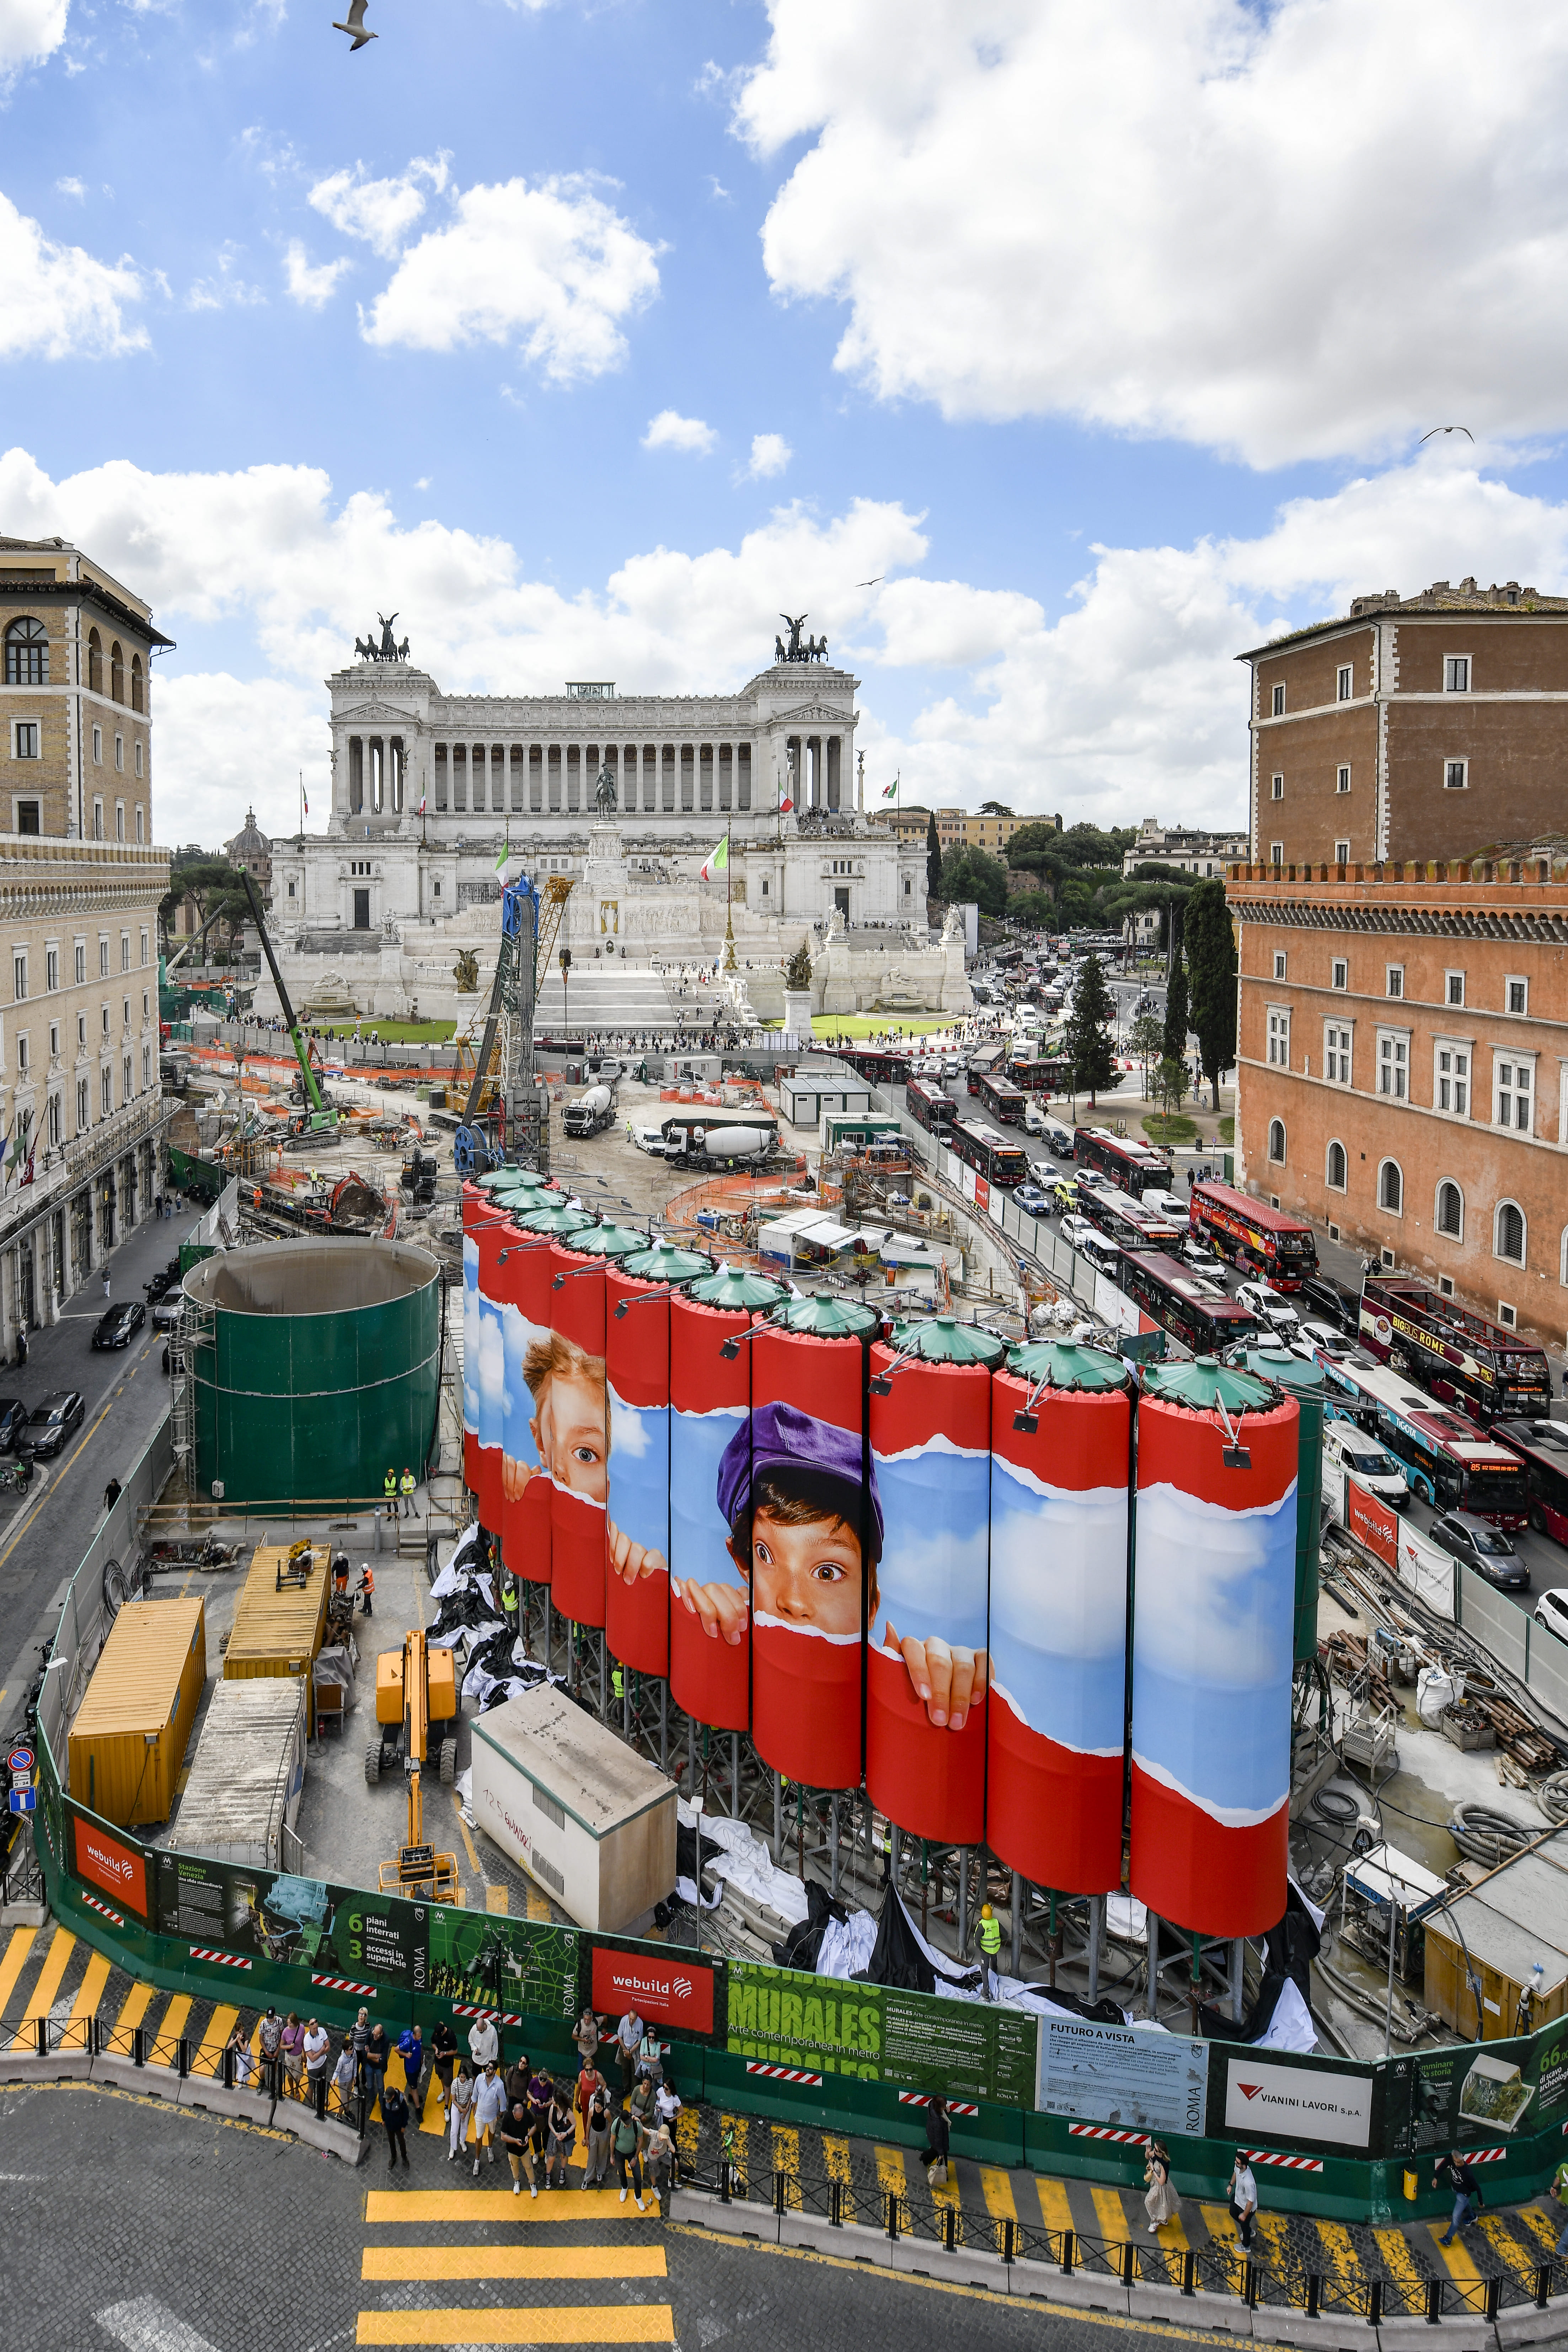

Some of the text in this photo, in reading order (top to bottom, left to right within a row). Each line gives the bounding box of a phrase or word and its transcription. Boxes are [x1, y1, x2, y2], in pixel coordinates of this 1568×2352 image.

[1419, 1332, 1445, 1355] ROME
[87, 1844, 120, 1872] webuild
[178, 1863, 206, 1874] Stazione
[178, 1869, 204, 1880] Venezia
[197, 1879, 223, 1889] straordinaria
[349, 1914, 363, 1932] 6
[366, 1916, 387, 1927] piani
[366, 1925, 399, 1939] interrati
[349, 1939, 362, 1959] 3
[366, 1945, 403, 1959] accessi in
[366, 1953, 406, 1968] superficie
[414, 1947, 425, 1988] ROMA
[613, 1976, 669, 1994] webuild
[563, 1973, 574, 2016] ROMA
[632, 1997, 658, 2005] Partecipazioni
[728, 1982, 880, 2053] MURALES
[886, 2006, 912, 2015] MURALES
[924, 2015, 963, 2024] contemporanea
[728, 2023, 880, 2060] Arte contemporanea in metro
[958, 2033, 986, 2041] internazionale
[1051, 2024, 1093, 2037] FUTURO
[1105, 2032, 1135, 2043] VISTA
[1431, 2068, 1451, 2077] storia
[1540, 2067, 1562, 2084] di scavo
[1186, 2087, 1201, 2132] ROMA
[1261, 2094, 1362, 2117] VIANINI LAVORI S.p.A.
